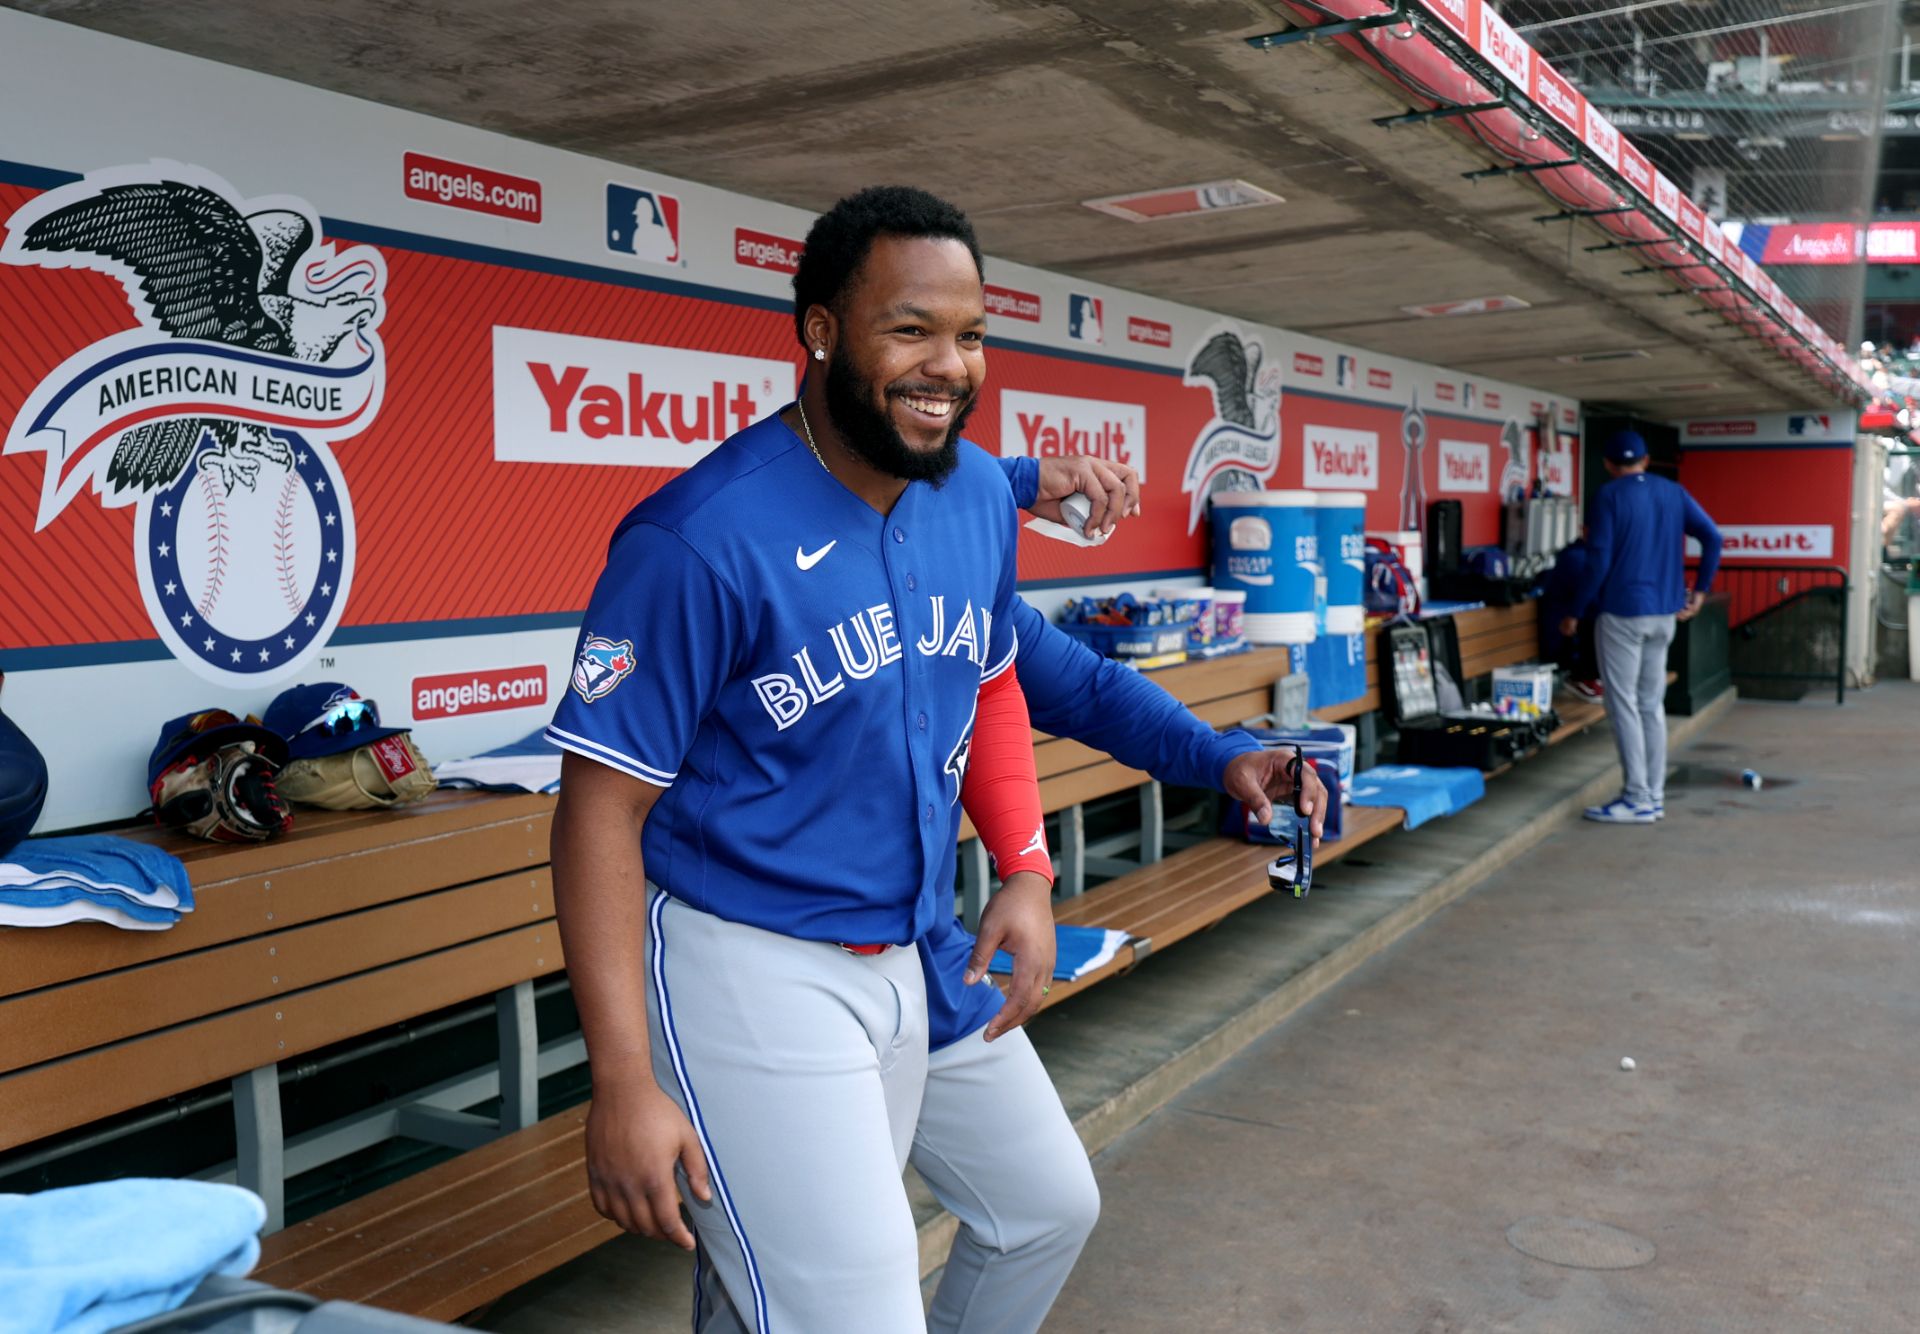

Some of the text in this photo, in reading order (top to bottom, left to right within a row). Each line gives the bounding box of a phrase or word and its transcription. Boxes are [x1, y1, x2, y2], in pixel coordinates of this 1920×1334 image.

[410, 167, 538, 213] angels.com
[738, 239, 800, 267] angels.c
[984, 291, 1040, 317] angels.com
[99, 366, 343, 416] AMERICAN LEAGUE
[526, 361, 757, 445] Yakult
[1016, 412, 1131, 465] Yakult
[1312, 442, 1371, 479] Yakult
[1721, 533, 1814, 551] akult
[320, 657, 335, 669] TM
[751, 595, 993, 731] BLUE JA
[417, 672, 544, 713] angels.com
